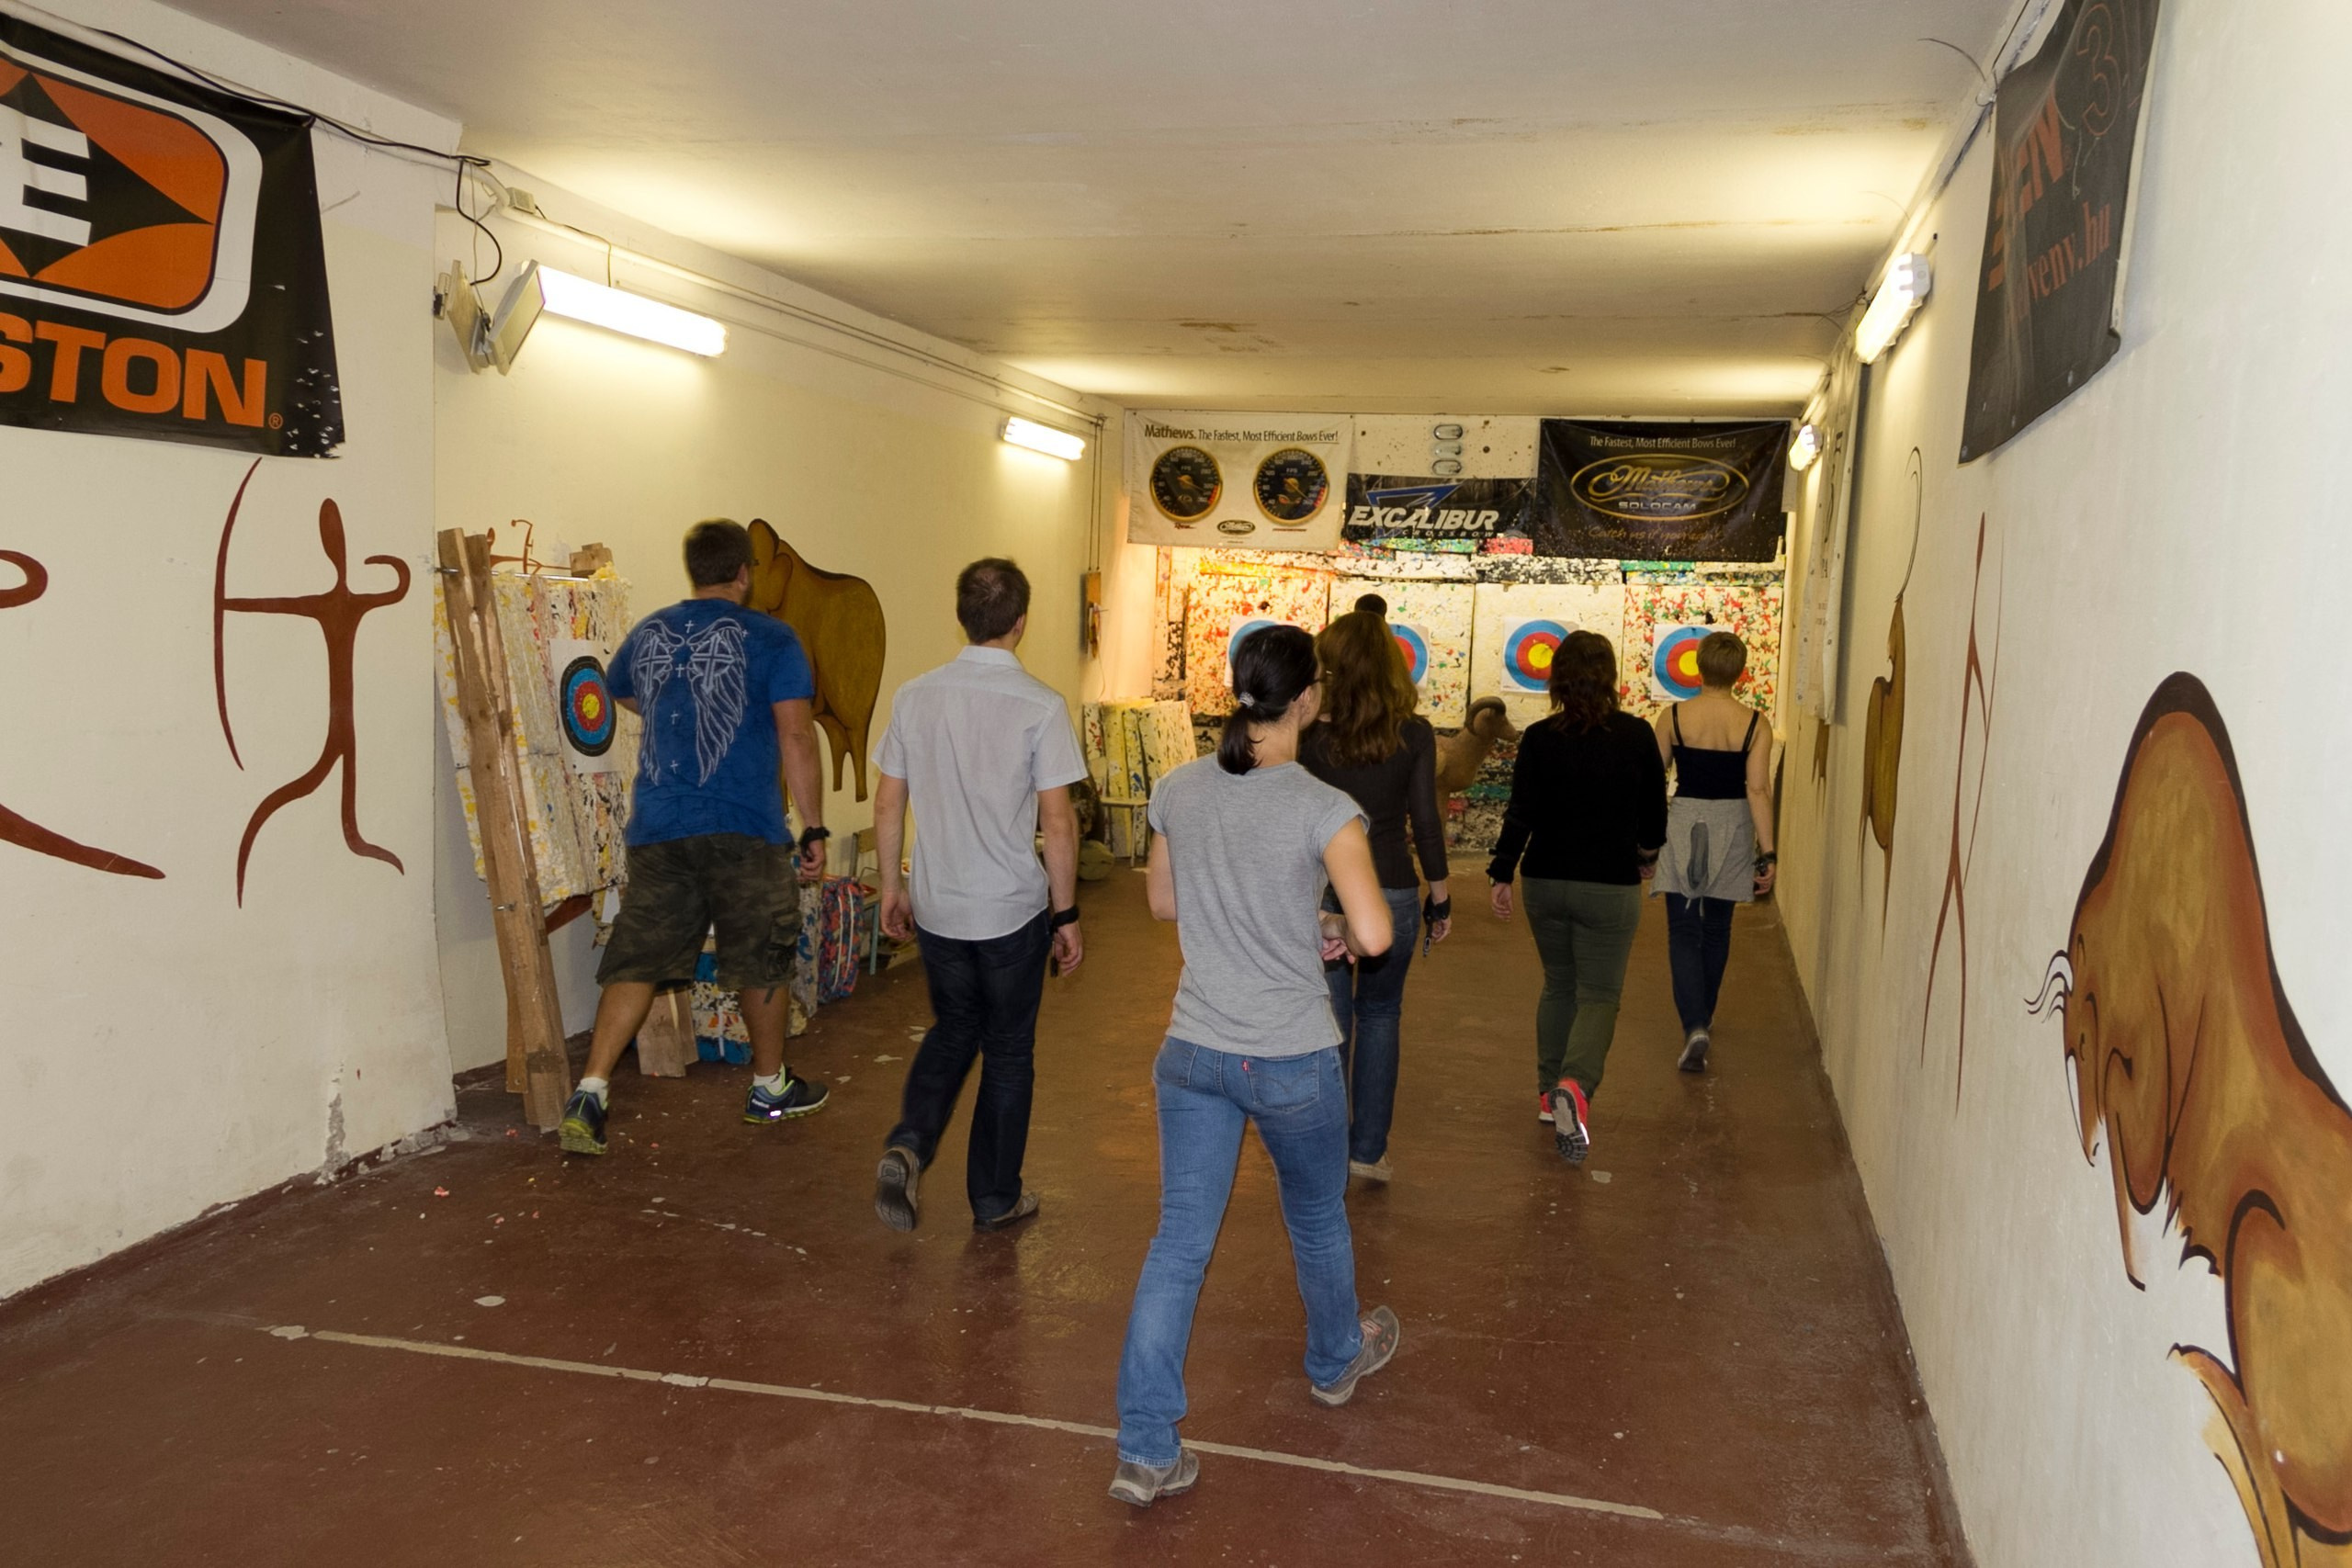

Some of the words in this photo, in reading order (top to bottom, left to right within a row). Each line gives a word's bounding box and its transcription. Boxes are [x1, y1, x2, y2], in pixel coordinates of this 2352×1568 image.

[1199, 429, 1212, 441] The
[1214, 430, 1240, 443] Fastest,
[1243, 431, 1262, 442] Most
[1263, 430, 1295, 442] Efficient
[1296, 431, 1318, 442] Bows
[1319, 431, 1340, 442] Ever!
[1589, 435, 1603, 447] The
[1604, 436, 1634, 448] Fastest,
[1635, 437, 1657, 448] Most
[1657, 437, 1690, 448] Efficient
[1692, 438, 1714, 448] Bows
[1715, 437, 1736, 448] Ever!
[1618, 501, 1696, 510] SOLOCAM
[1348, 505, 1499, 530] EXCALIBUR
